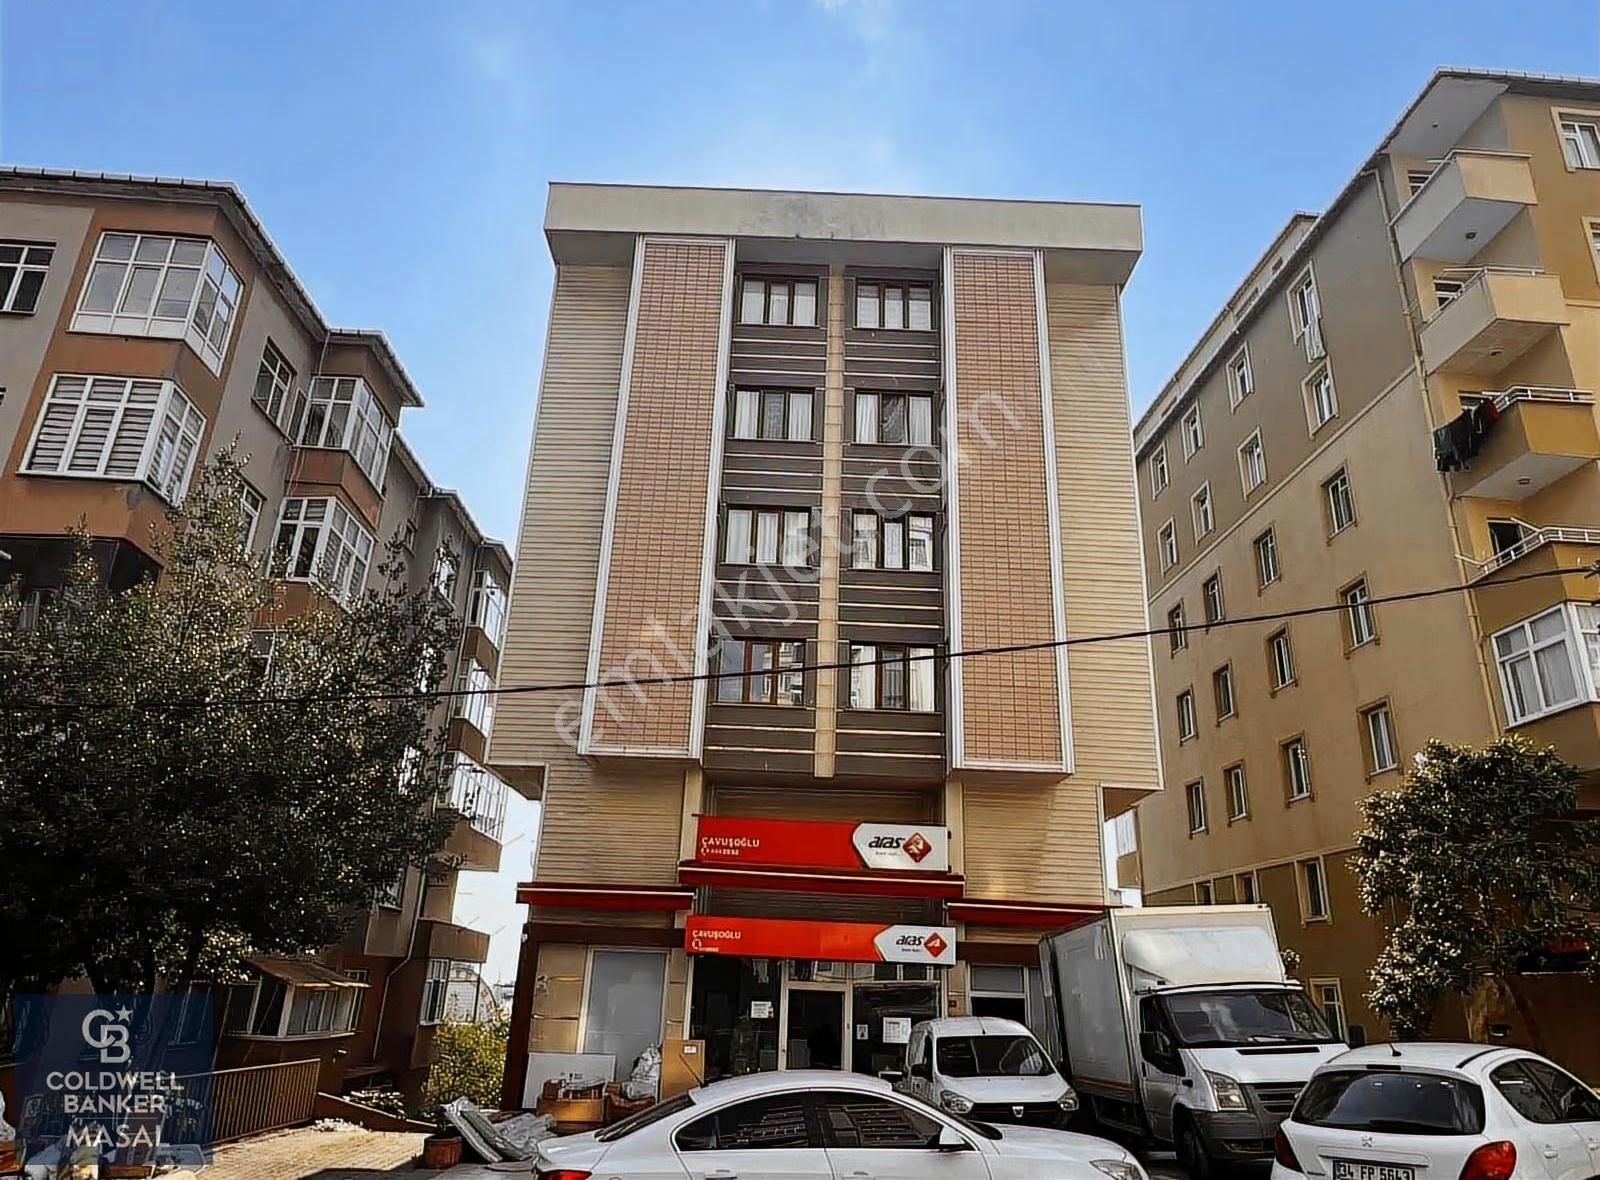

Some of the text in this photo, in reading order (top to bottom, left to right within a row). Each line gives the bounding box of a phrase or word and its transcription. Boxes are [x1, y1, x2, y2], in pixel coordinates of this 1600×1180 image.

[702, 837, 759, 848] ÇAVUŞOĞLU
[868, 836, 906, 848] aras
[896, 935, 925, 946] aras
[1338, 1163, 1354, 1178] 34
